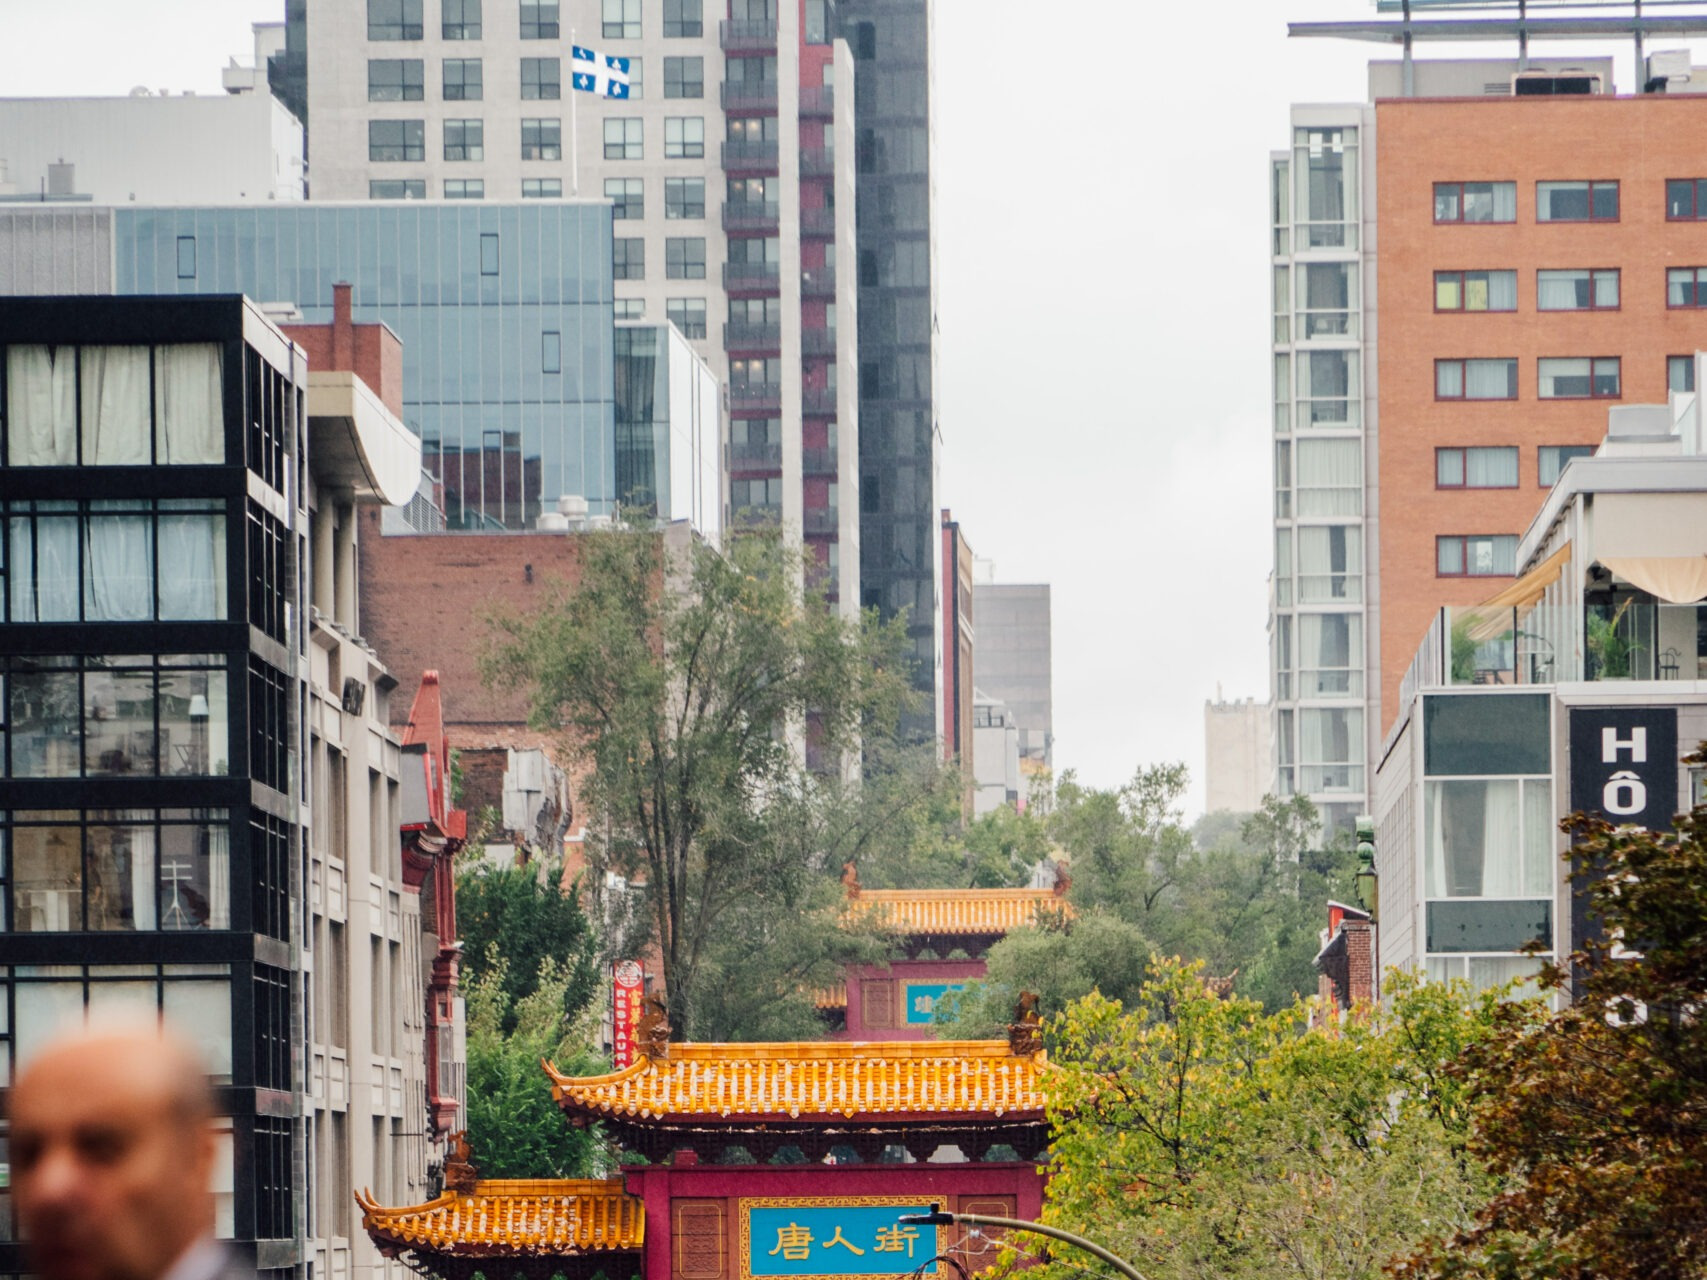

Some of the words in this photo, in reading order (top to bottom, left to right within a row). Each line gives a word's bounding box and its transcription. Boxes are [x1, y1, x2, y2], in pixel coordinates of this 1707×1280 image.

[1602, 727, 1647, 959] HÔL
[768, 1222, 920, 1260] 唐人街
